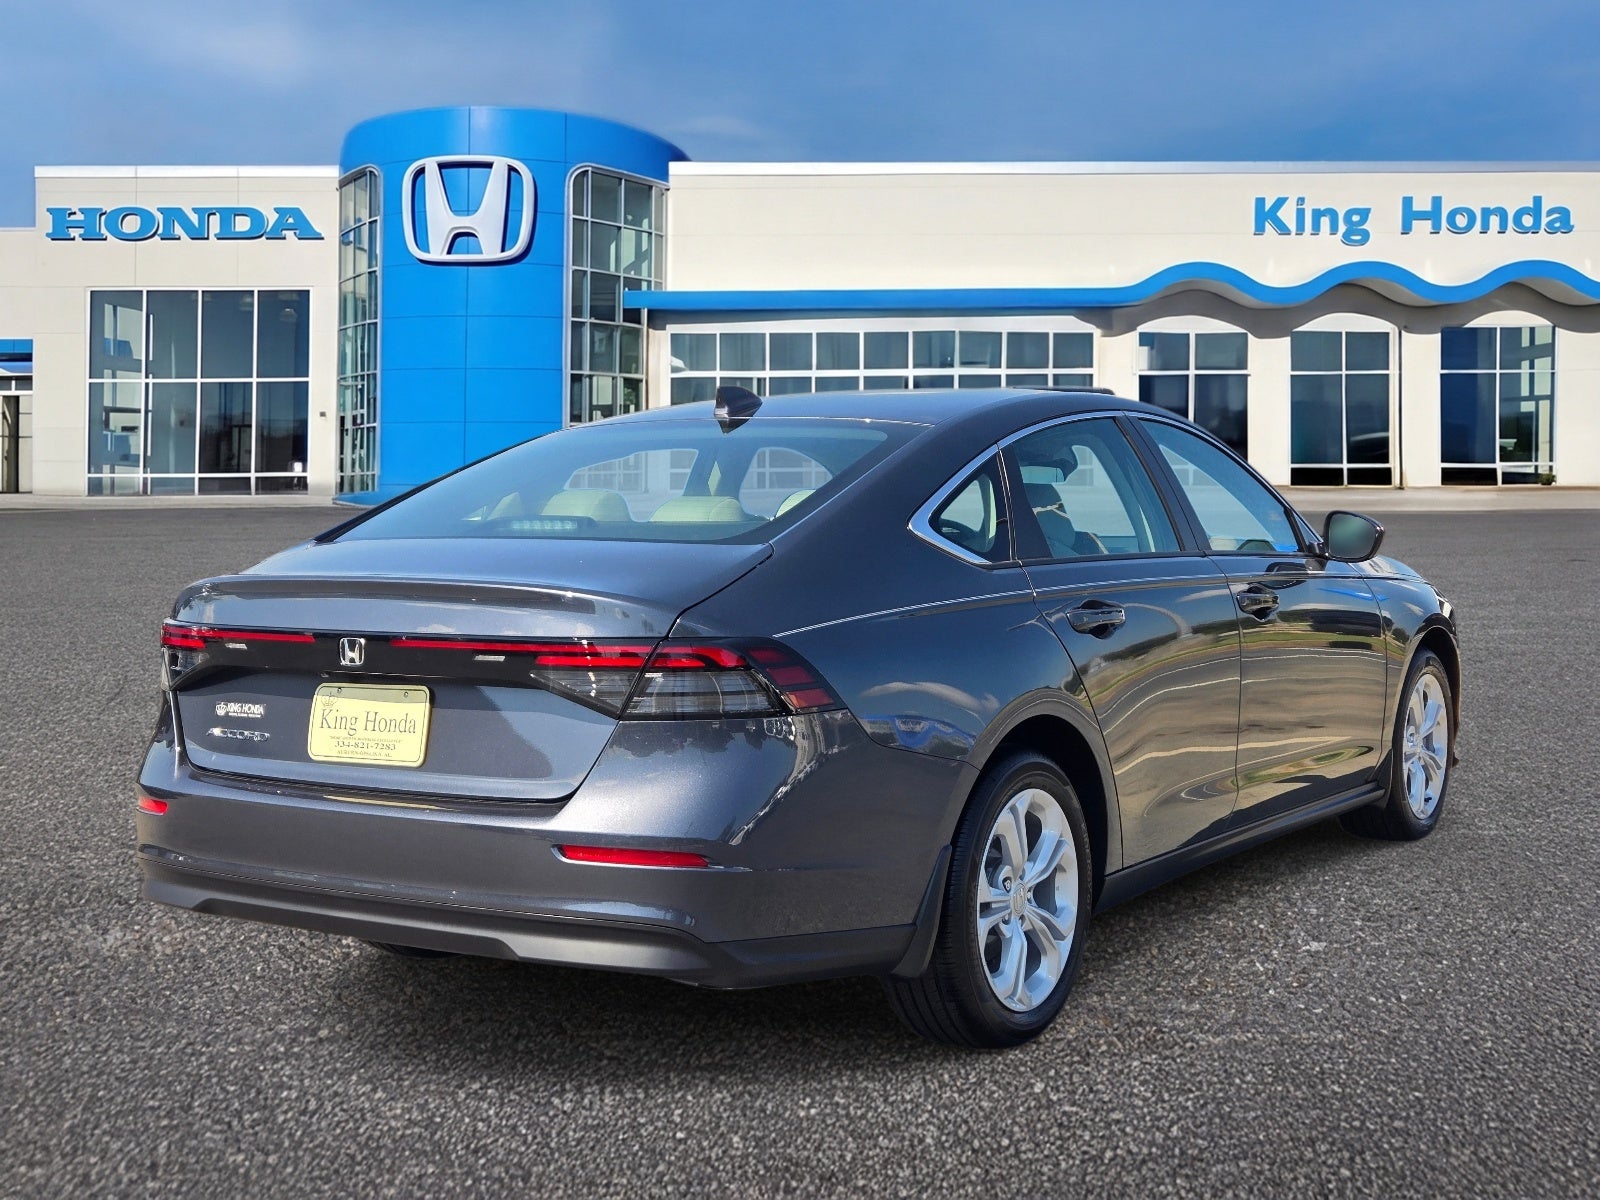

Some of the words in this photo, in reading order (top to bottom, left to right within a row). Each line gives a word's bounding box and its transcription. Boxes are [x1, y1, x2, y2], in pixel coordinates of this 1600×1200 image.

[45, 206, 324, 241] HONDA
[1254, 196, 1372, 246] King
[1401, 195, 1575, 235] Honda
[227, 702, 242, 713] KING
[242, 703, 264, 715] HONDA
[319, 708, 358, 737] King
[363, 710, 417, 734] Honda
[334, 740, 396, 751] 334-821-7283
